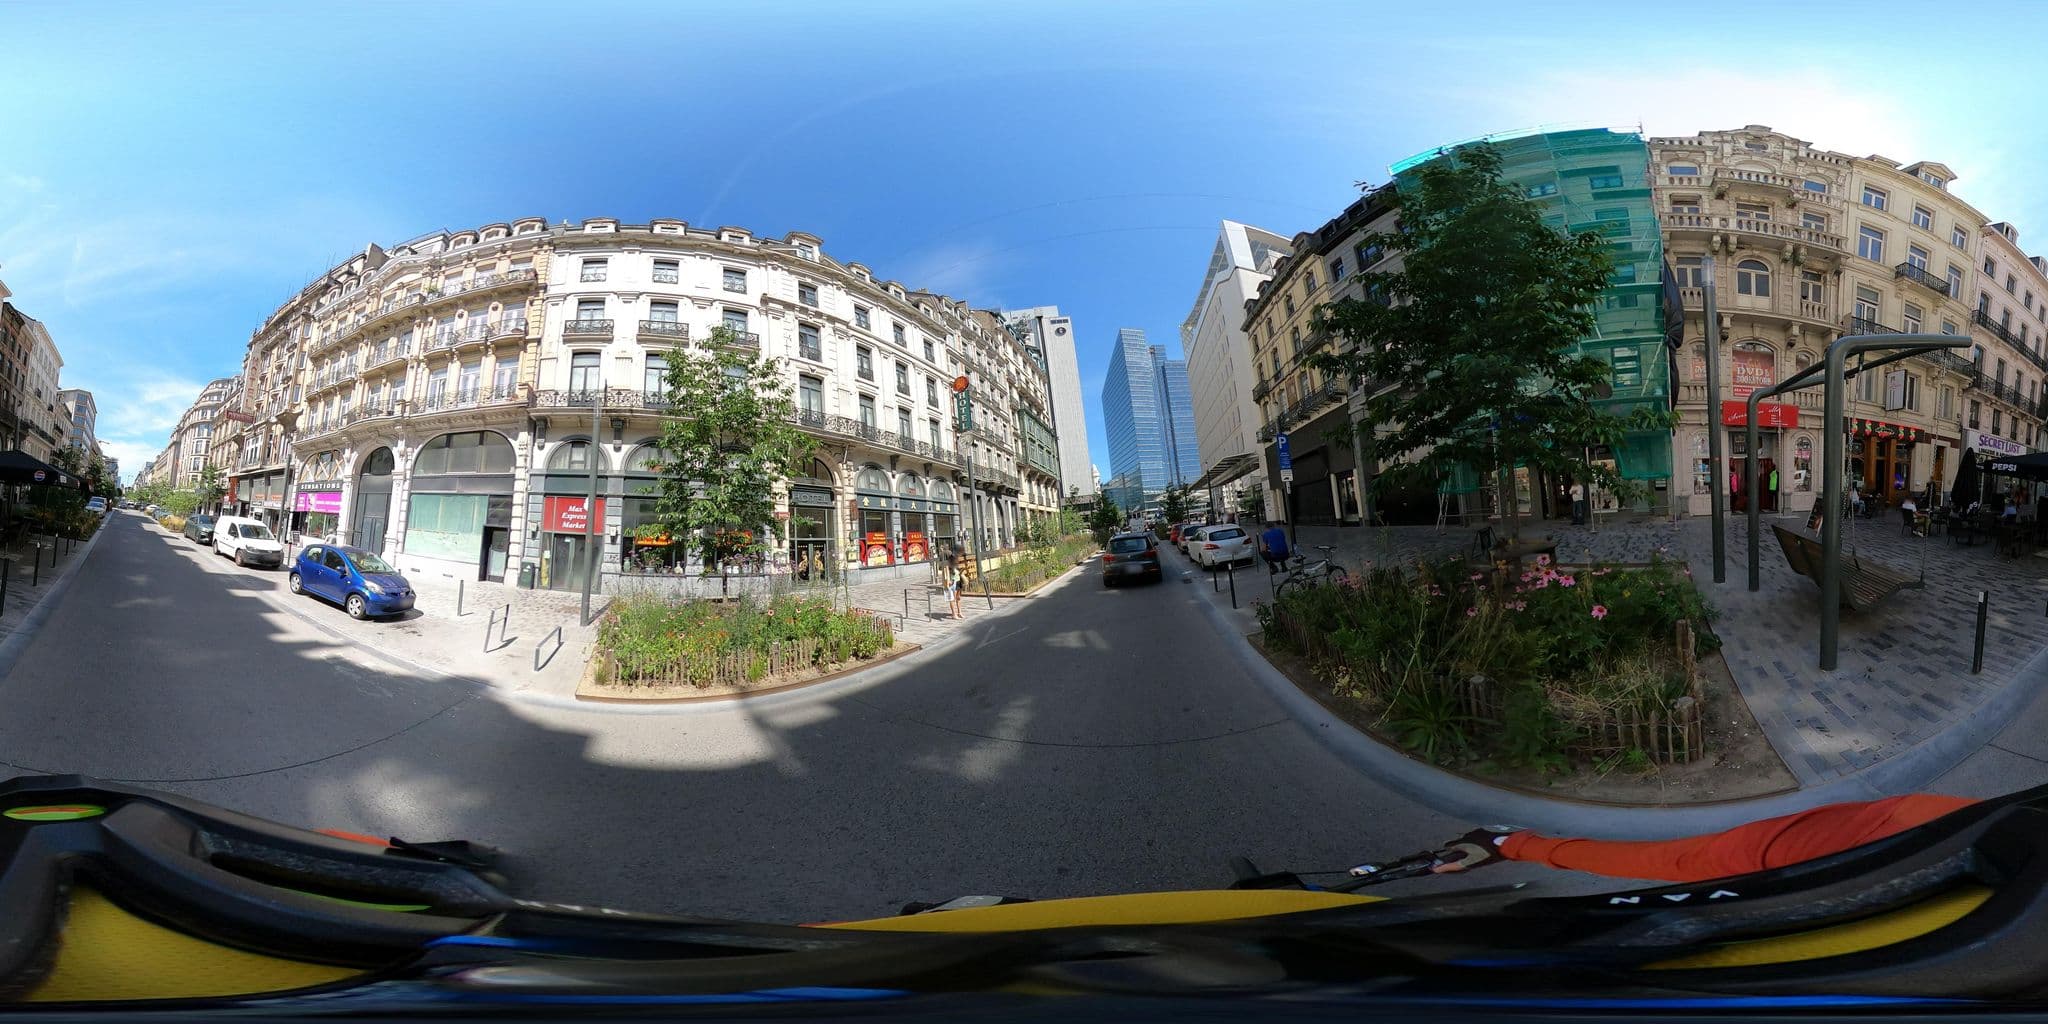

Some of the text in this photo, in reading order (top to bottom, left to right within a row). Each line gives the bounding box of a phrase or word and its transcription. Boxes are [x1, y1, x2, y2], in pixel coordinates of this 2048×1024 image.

[959, 391, 968, 430] HOTEL
[1278, 436, 1287, 449] P
[1979, 434, 2020, 453] SECRET LUST
[1992, 463, 2017, 472] PEPSI
[301, 482, 340, 490] SENSATIONS
[792, 491, 829, 503] HOTEL
[561, 512, 587, 520] Express
[562, 521, 586, 529] Market
